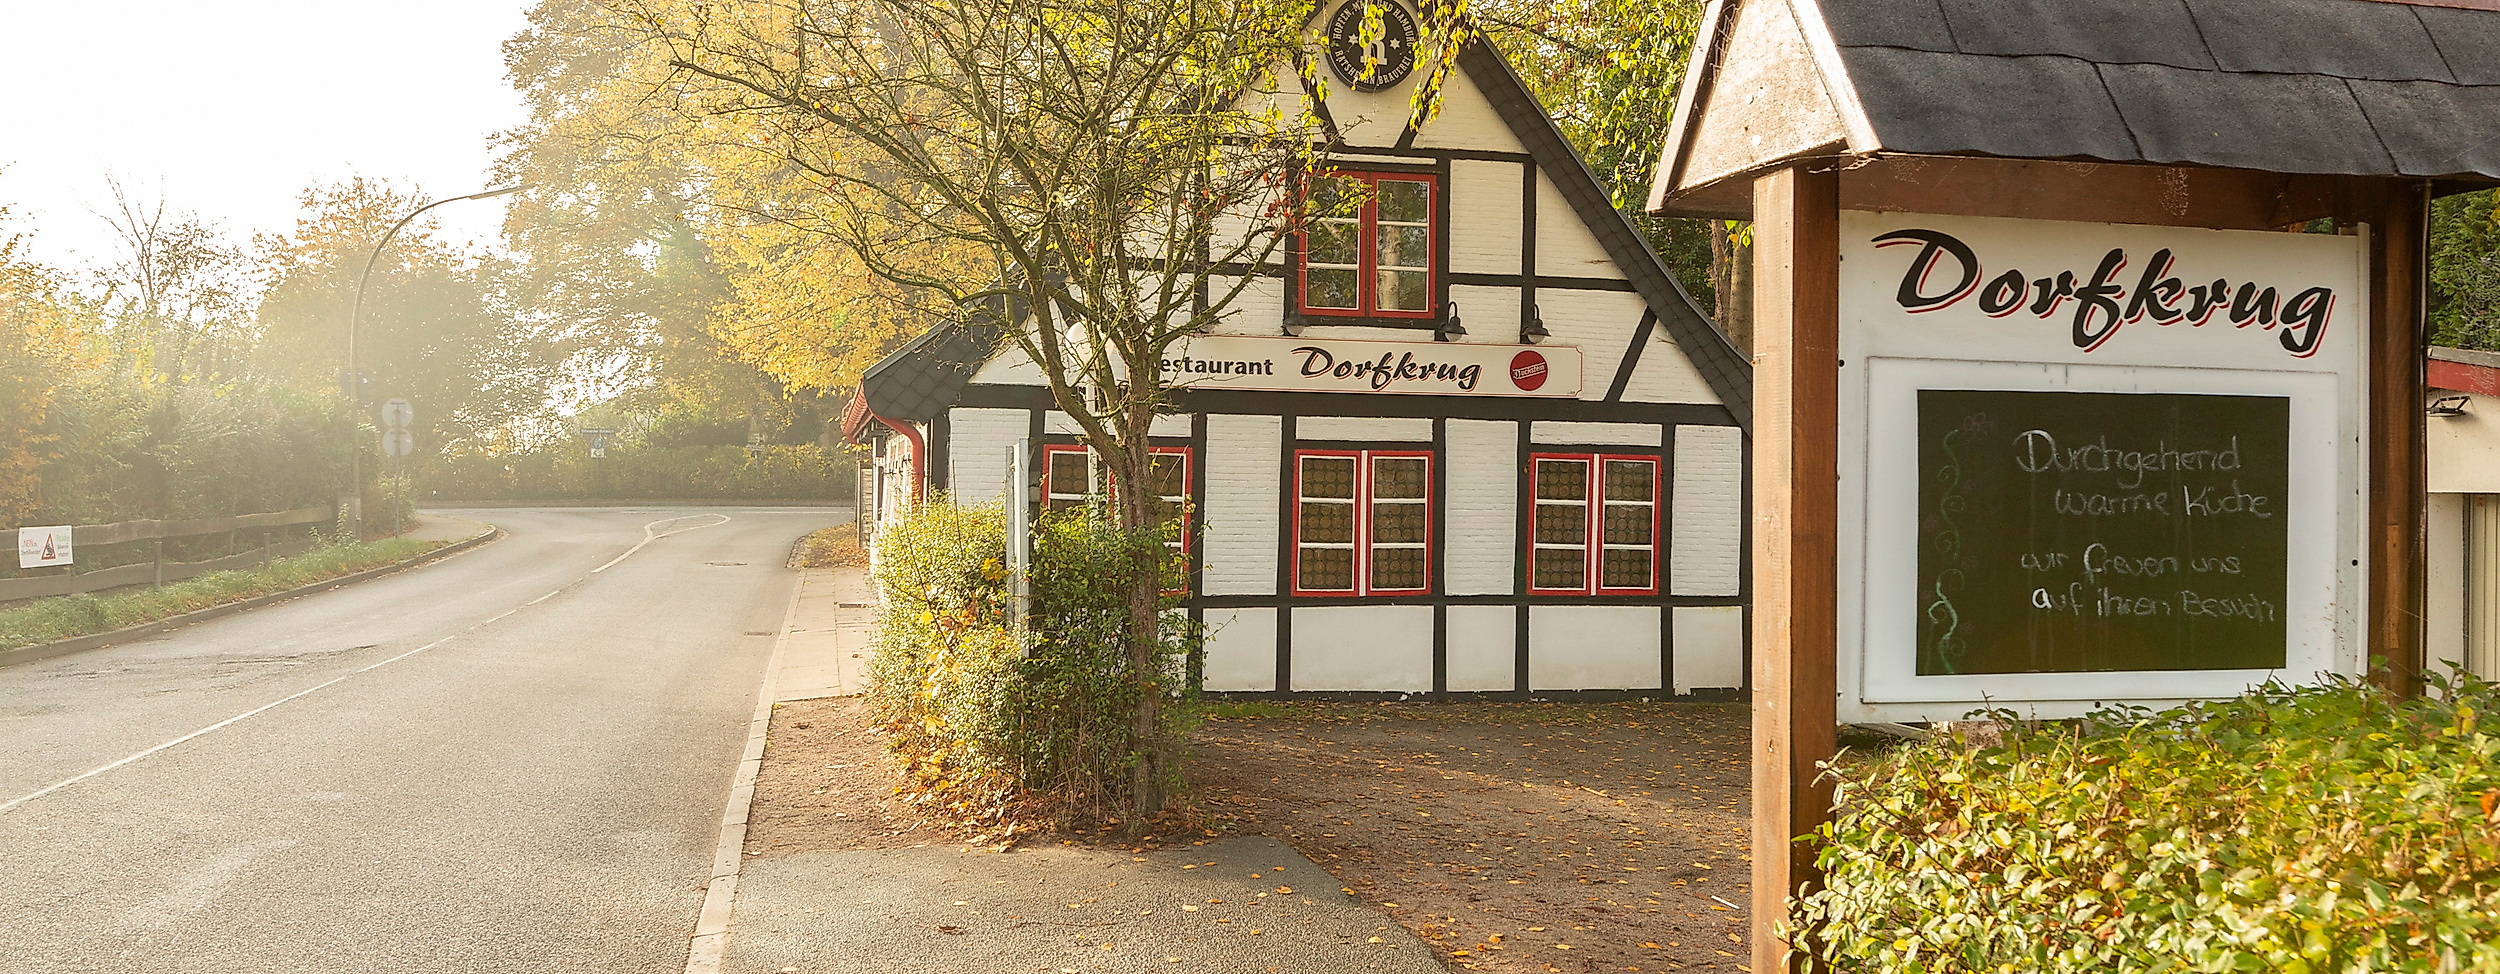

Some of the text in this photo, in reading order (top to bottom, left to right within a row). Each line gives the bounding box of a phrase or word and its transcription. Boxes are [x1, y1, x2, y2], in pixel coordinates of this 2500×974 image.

[1392, 10, 1415, 47] HAMBURG
[1379, 56, 1412, 85] BRAUEREI
[1871, 228, 2336, 358] Dorfkrug
[1159, 346, 1482, 392] estaurant Dorfkrug
[2012, 429, 2241, 489] Durchgehend
[2184, 480, 2272, 517] Küche
[2191, 556, 2240, 574] uns
[2032, 582, 2084, 616] auf
[2180, 590, 2275, 623] Besuch
